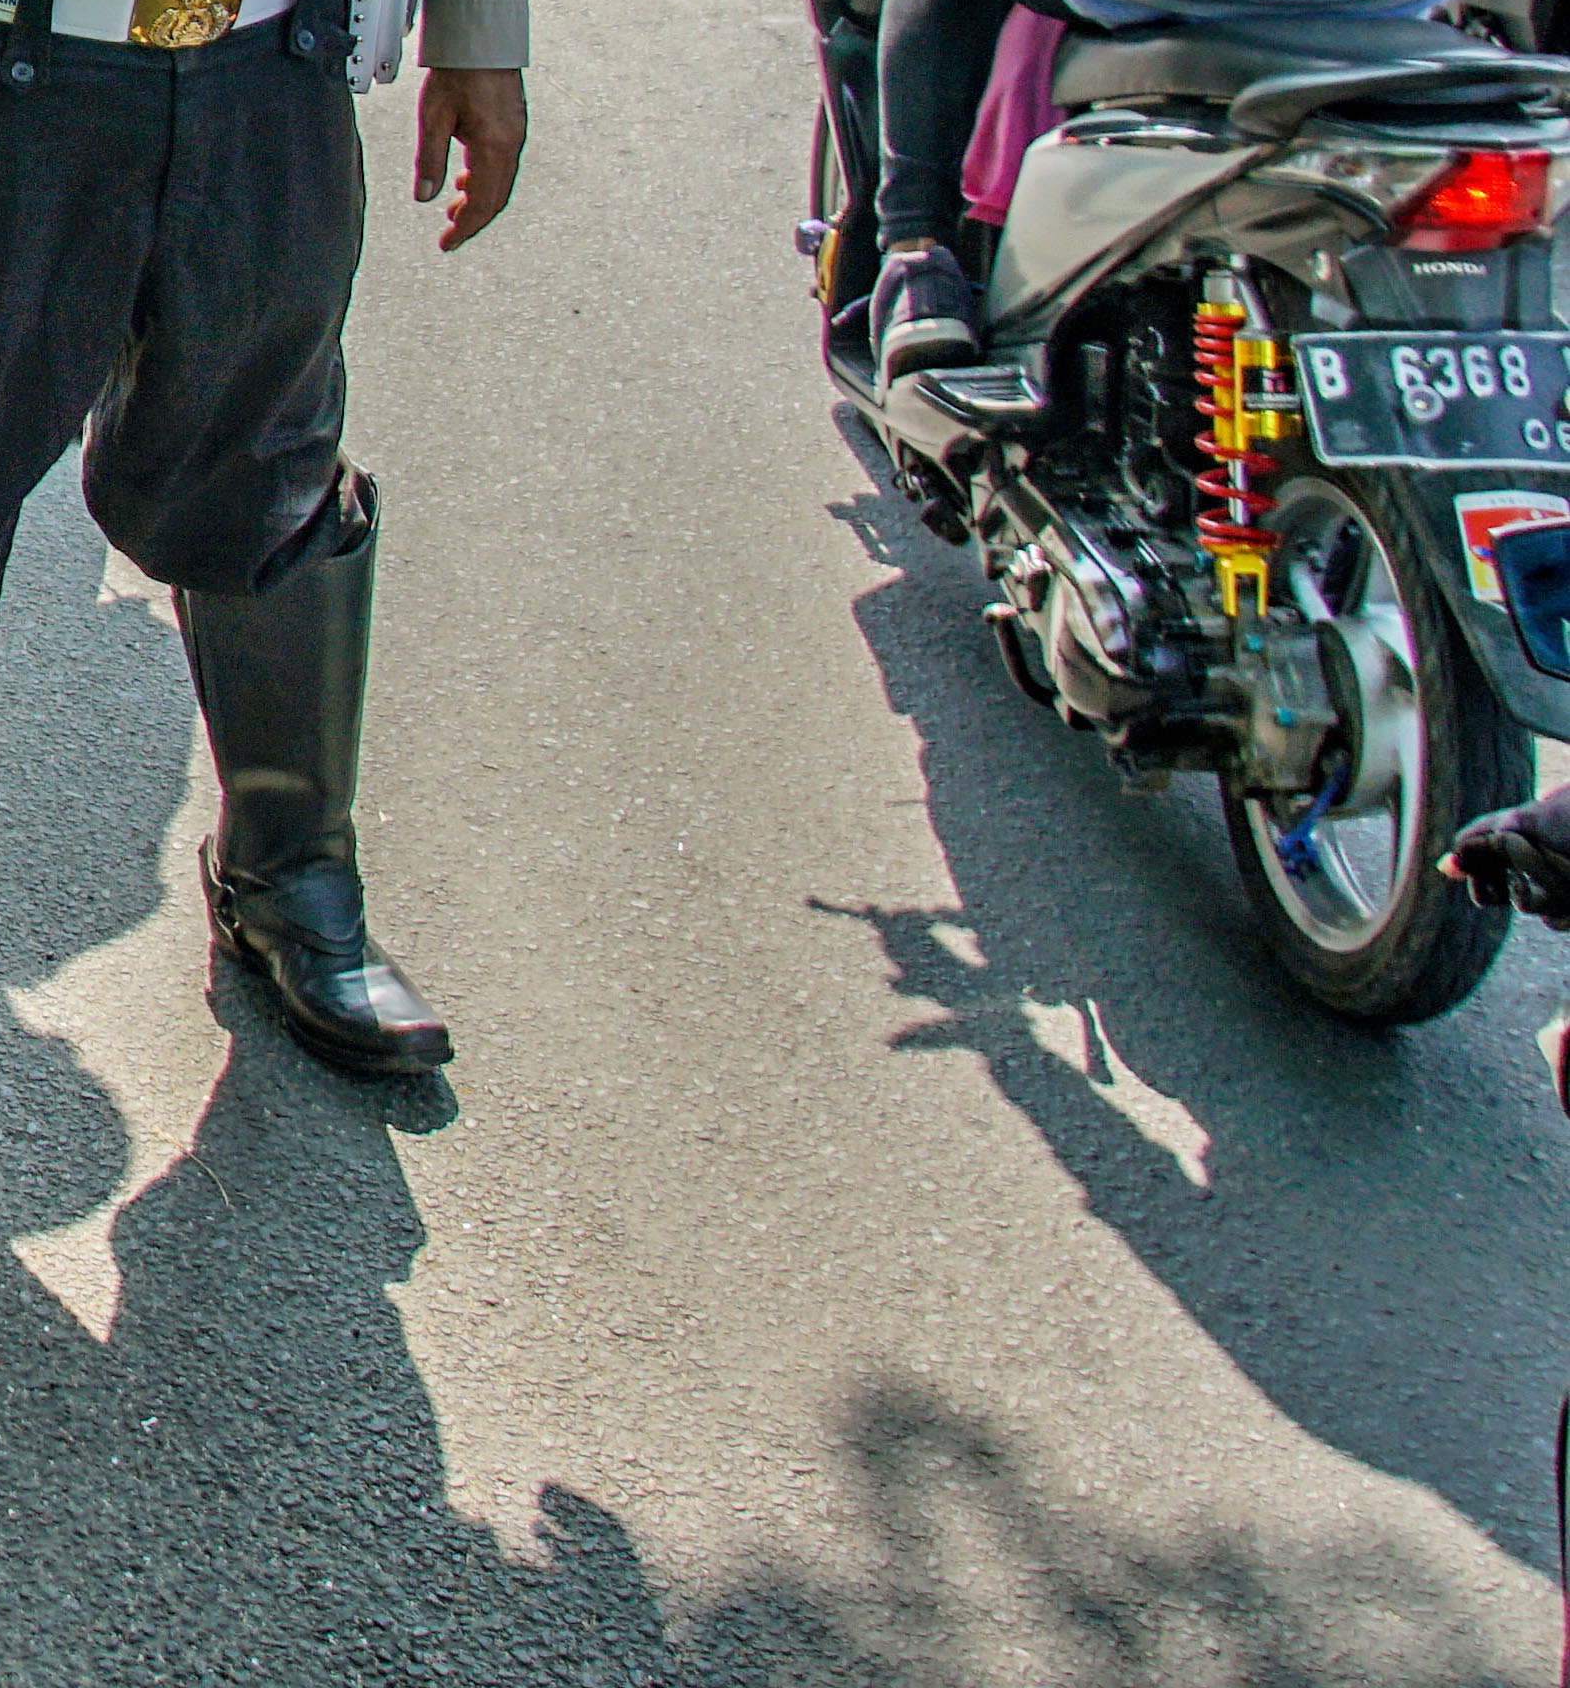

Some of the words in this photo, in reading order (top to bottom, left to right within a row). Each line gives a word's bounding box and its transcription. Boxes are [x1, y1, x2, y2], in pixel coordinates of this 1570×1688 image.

[1411, 261, 1488, 275] HONDA
[1308, 346, 1347, 398] B
[1391, 345, 1532, 399] 6368
